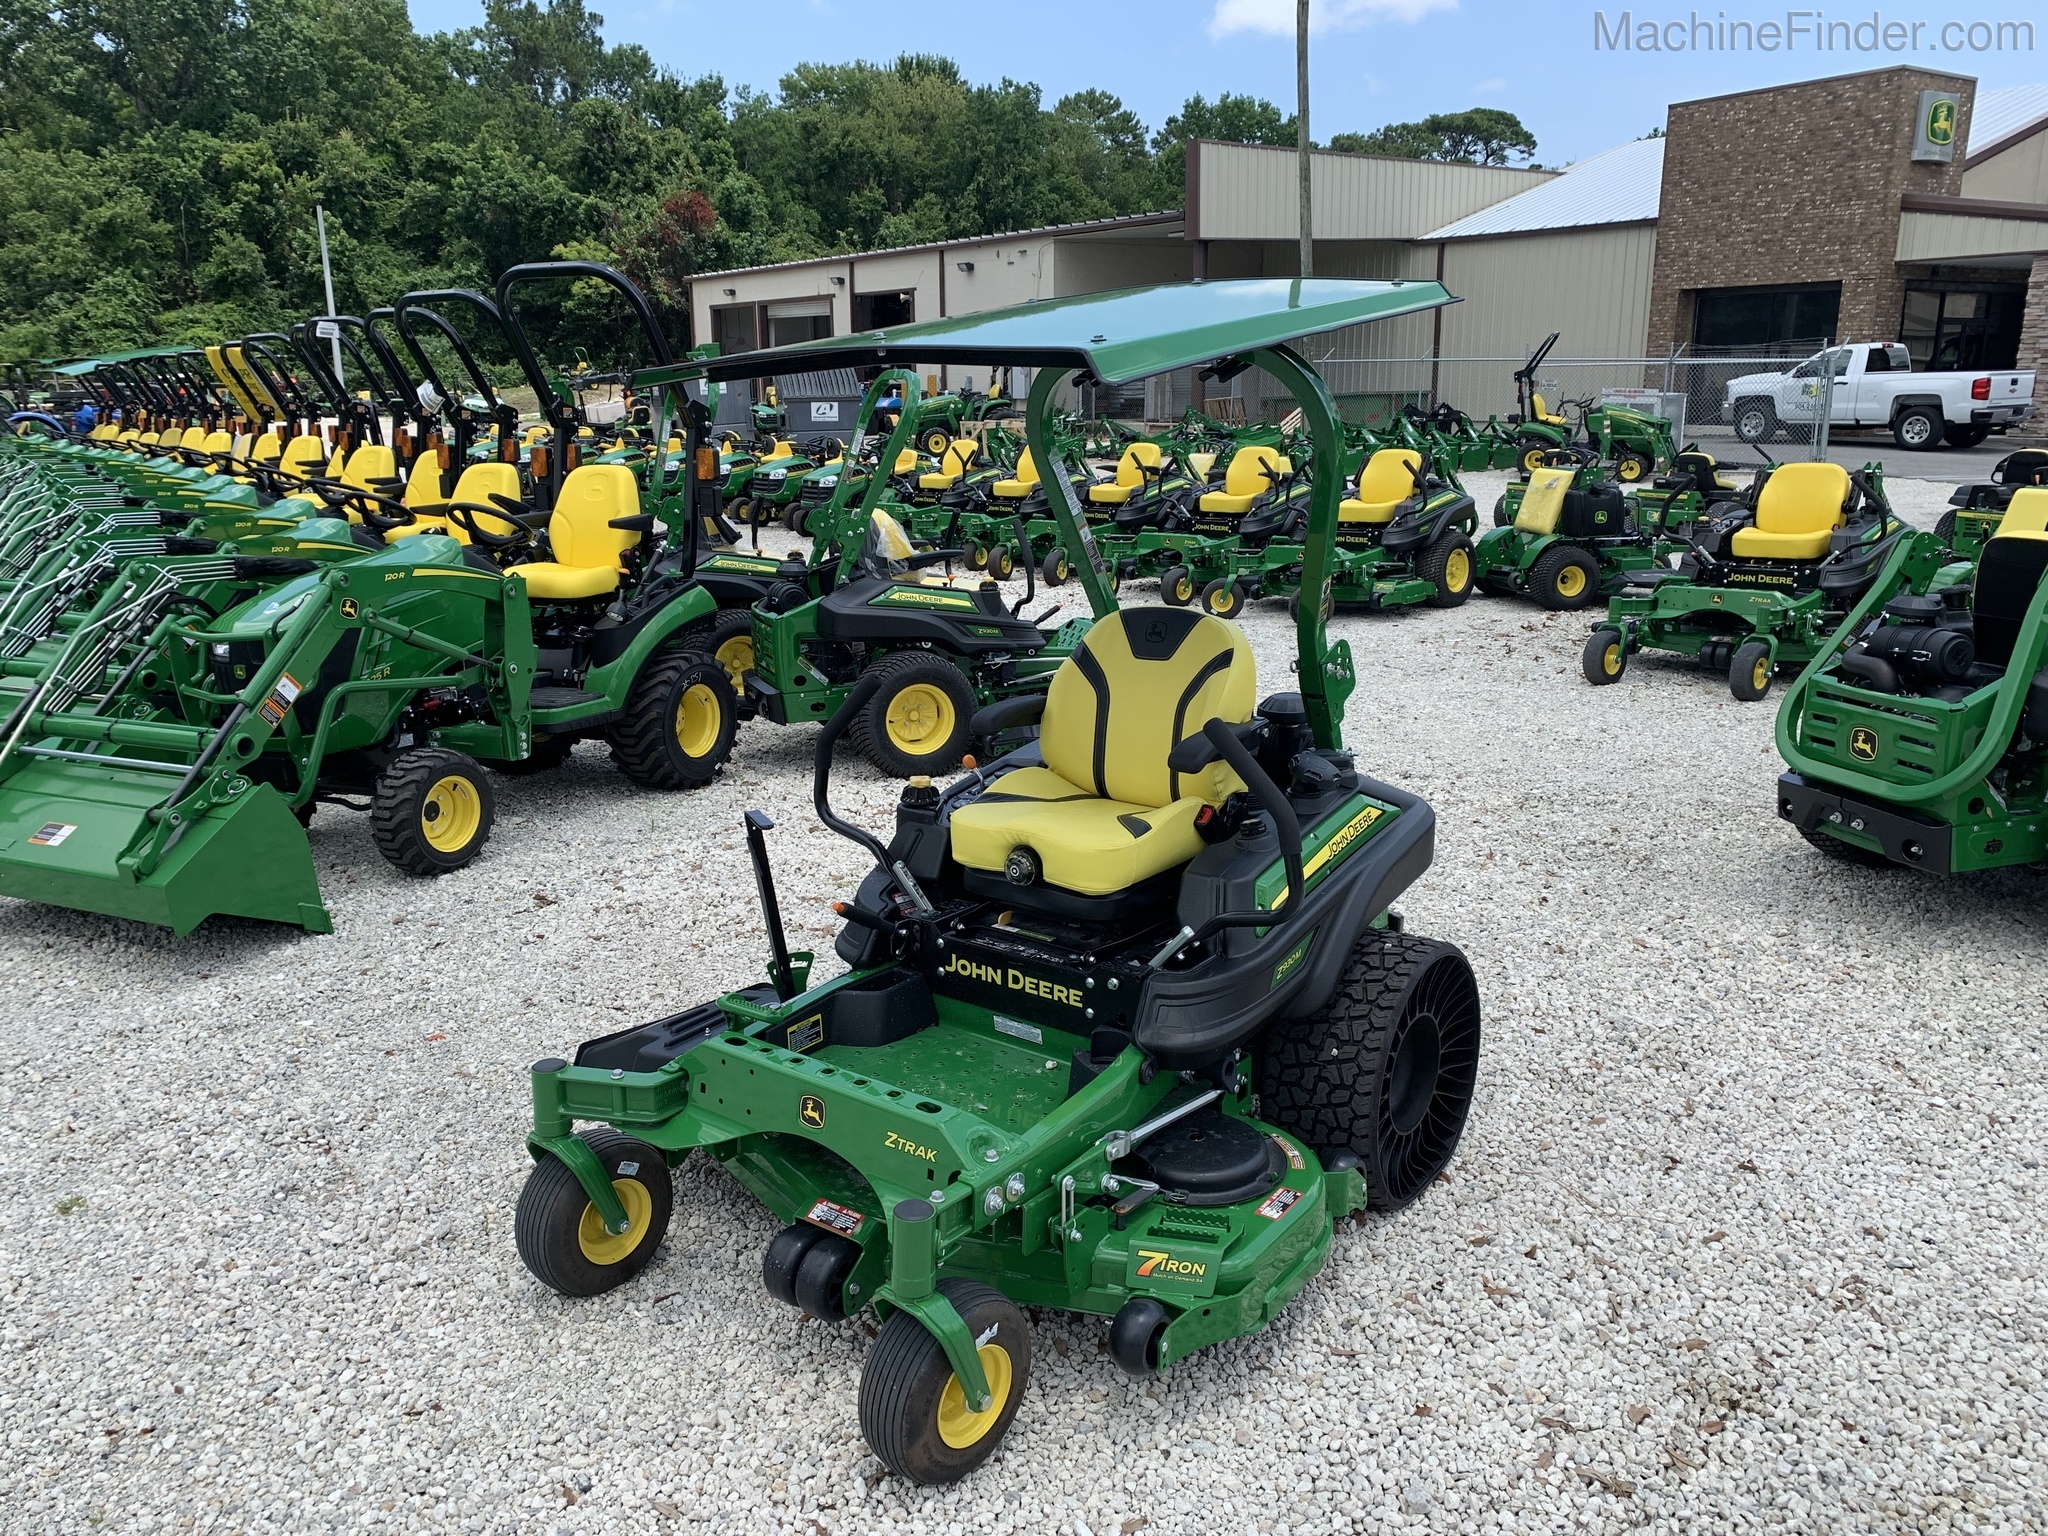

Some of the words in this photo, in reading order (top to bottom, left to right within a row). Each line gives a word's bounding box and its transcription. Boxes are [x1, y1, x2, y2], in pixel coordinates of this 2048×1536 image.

[1346, 535, 1368, 543] DEERE
[384, 572, 398, 581] 120
[399, 571, 406, 579] R
[1728, 572, 1756, 583] JOHN
[1757, 574, 1794, 584] DEERE
[897, 593, 918, 601] JOHN
[918, 595, 944, 604] DEERE
[1749, 596, 1773, 604] ZTRAK
[1327, 834, 1349, 861] JOHN
[1348, 810, 1375, 840] DEERE
[1276, 948, 1302, 980] Z930M
[945, 953, 1002, 985] JOHN
[1007, 968, 1083, 1008] DEERE
[884, 1131, 938, 1163] ZTRAK
